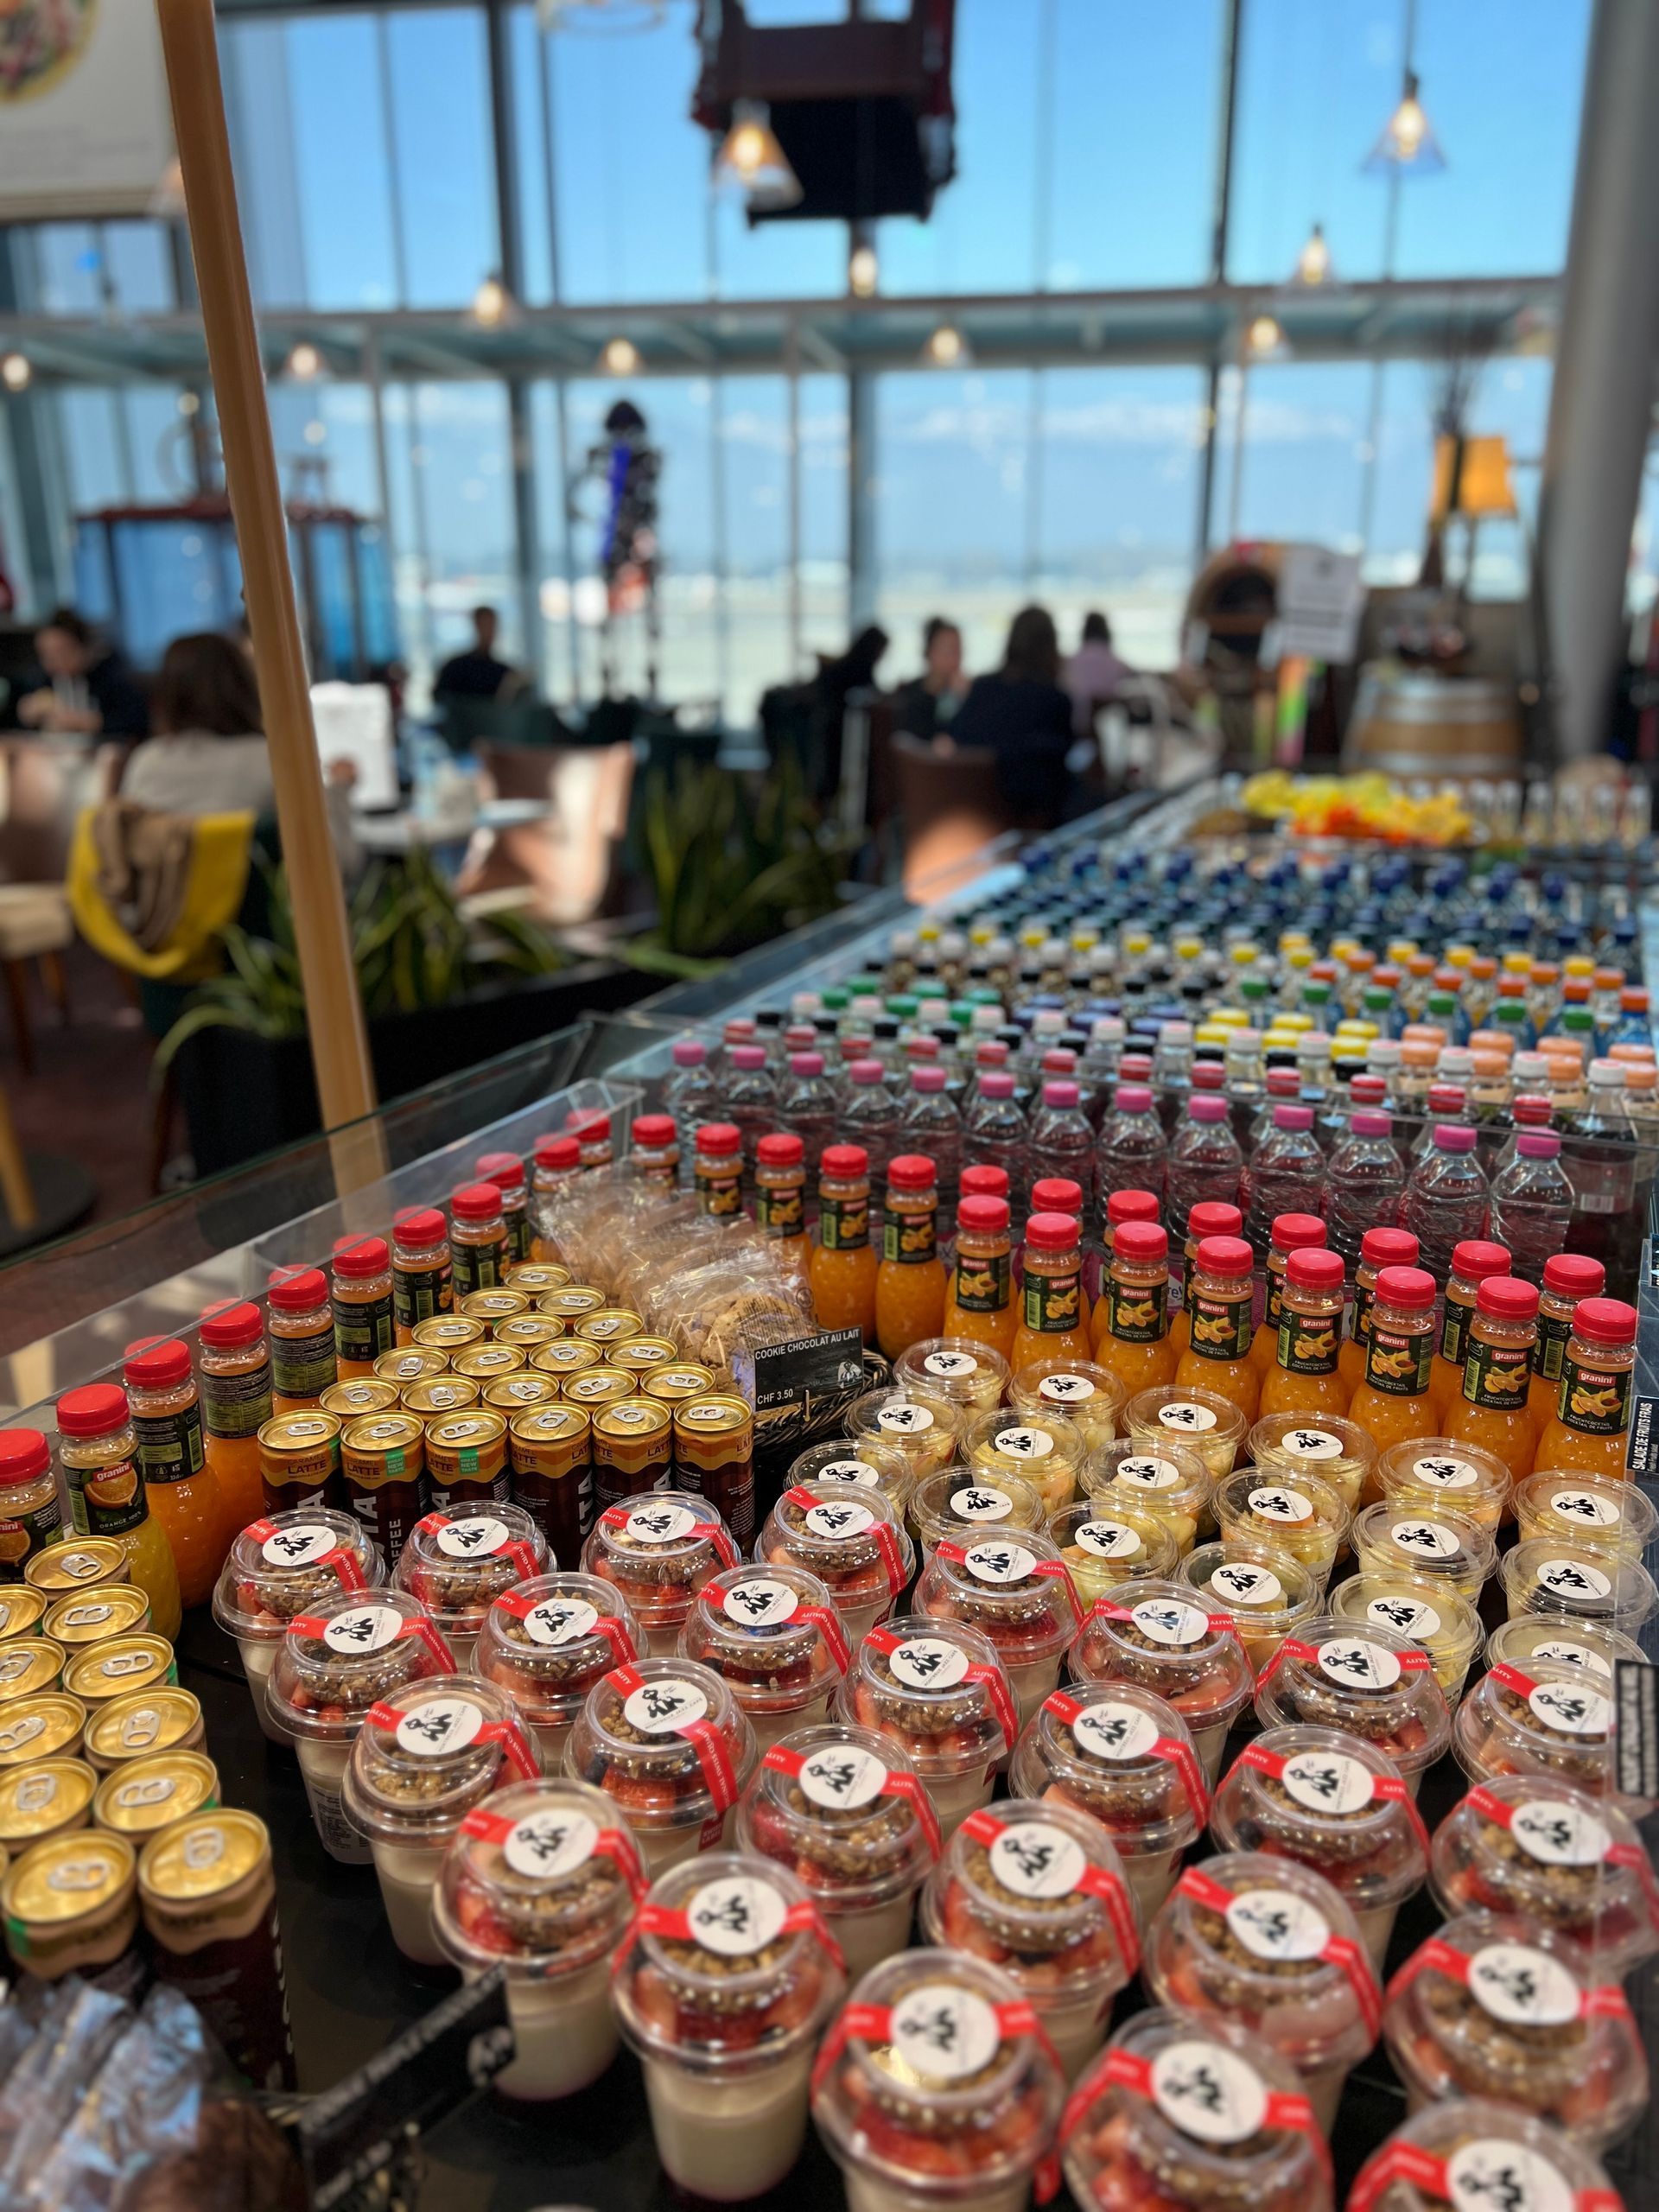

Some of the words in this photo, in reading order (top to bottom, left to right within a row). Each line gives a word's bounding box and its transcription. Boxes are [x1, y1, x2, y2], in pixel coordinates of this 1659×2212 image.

[1122, 1288, 1149, 1299] granini
[1199, 1302, 1225, 1314] granini
[1302, 1319, 1331, 1329] granini
[755, 1345, 786, 1360] COOKIE
[787, 1335, 830, 1353] CHOCOLAT
[831, 1333, 842, 1344] AU
[842, 1328, 861, 1340] LAIT
[1377, 1333, 1406, 1346] granini
[1496, 1351, 1524, 1362] granini
[1580, 1372, 1612, 1384] granini
[757, 1392, 775, 1405] CHF
[777, 1388, 793, 1401] 3.50
[1638, 1402, 1653, 1419] FRAIS
[1636, 1418, 1651, 1438] FRUITS
[571, 1440, 592, 1459] LATT
[594, 1446, 613, 1458] ATTE
[648, 1440, 671, 1458] LATT
[512, 1452, 537, 1465] ATTE
[1632, 1446, 1647, 1470] SALADE
[96, 1463, 130, 1480] granini
[288, 1461, 327, 1474] LATTE
[346, 1462, 380, 1476] LATTE
[428, 1459, 454, 1472] ATTE
[790, 1489, 804, 1498] ALITY
[99, 1517, 127, 1529] ORANGE
[604, 1512, 623, 1521] ALITY
[0, 1522, 18, 1531] nini
[391, 1518, 403, 1568] OFFEE
[887, 1543, 895, 1560] SWISS
[499, 1595, 516, 1605] ALITY
[1282, 1644, 1302, 1653] ALITY
[1492, 1667, 1512, 1680] ALITY
[1049, 1697, 1070, 1712] ALITY
[370, 1708, 391, 1721] ALITY
[1244, 1751, 1268, 1764] ALITY
